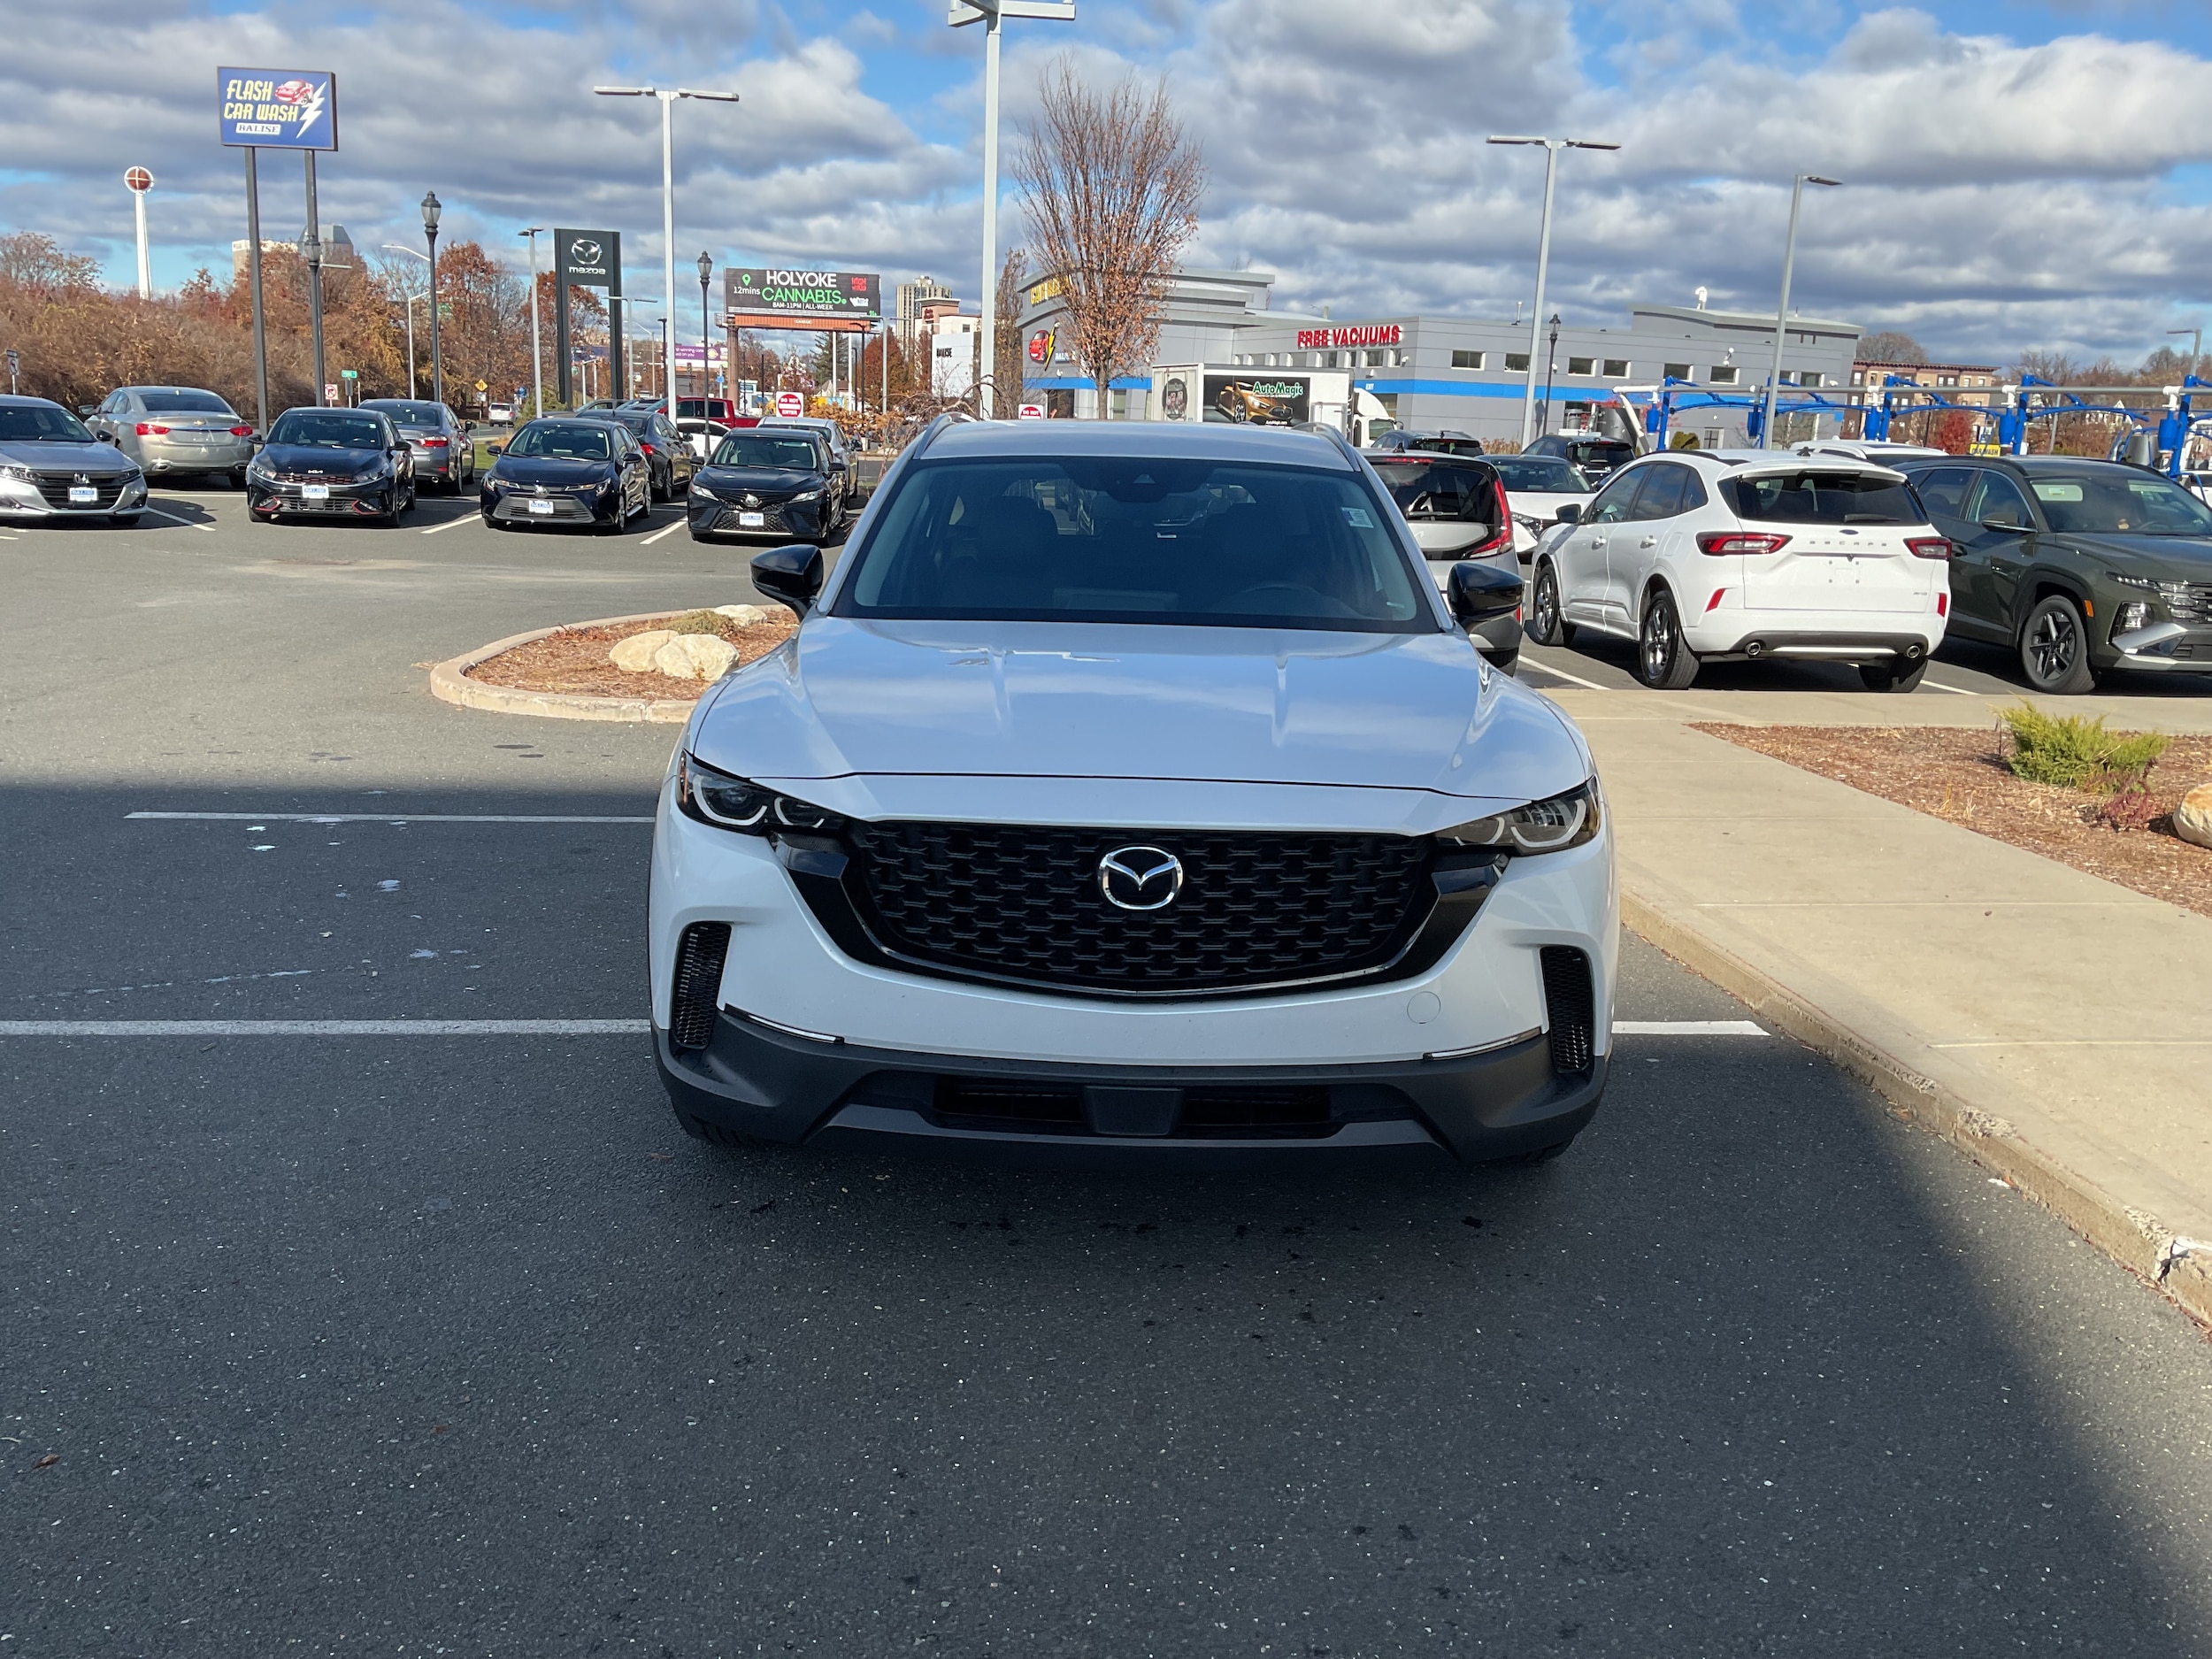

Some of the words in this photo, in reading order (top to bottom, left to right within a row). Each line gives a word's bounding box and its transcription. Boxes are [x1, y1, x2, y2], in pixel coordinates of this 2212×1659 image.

[227, 79, 273, 102] FLASH
[223, 102, 254, 120] CAR
[256, 104, 299, 122] WASH
[568, 266, 606, 275] mazda
[766, 270, 837, 288] HOLYOKE
[733, 287, 761, 296] 12mins
[1297, 329, 1330, 349] FREE
[1333, 324, 1402, 348] VACUUMS
